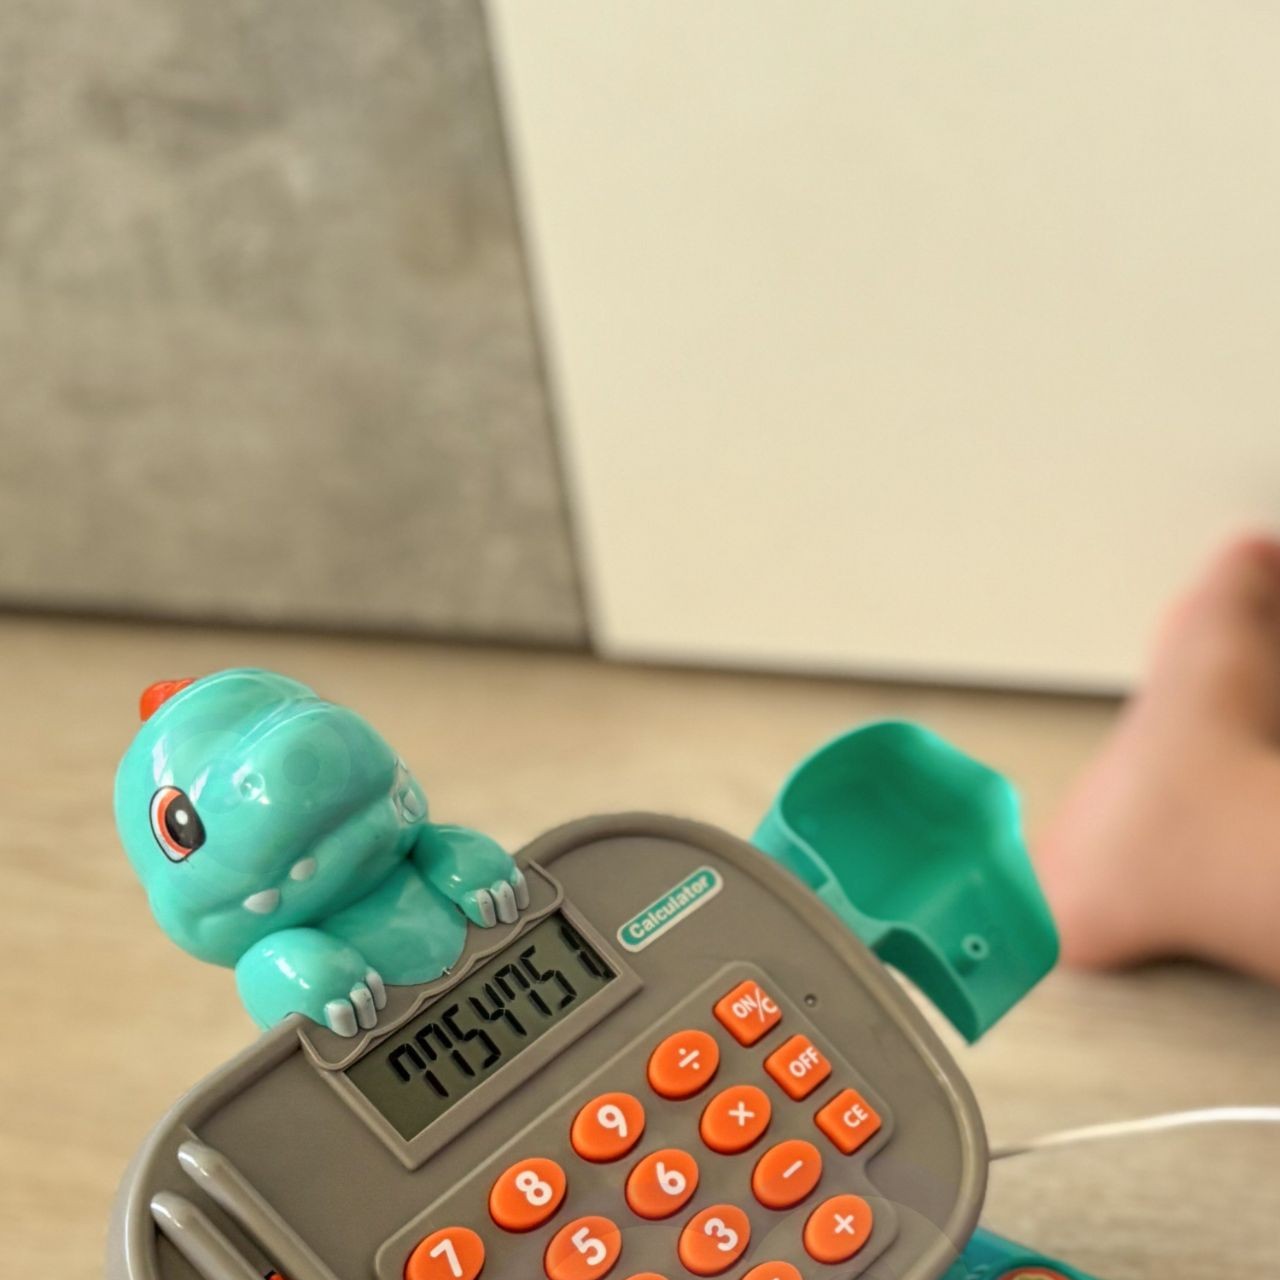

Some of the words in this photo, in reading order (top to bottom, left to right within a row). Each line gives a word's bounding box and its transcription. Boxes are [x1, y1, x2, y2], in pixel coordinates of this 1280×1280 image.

[628, 876, 709, 939] Calculator
[388, 926, 603, 1098] 7754751
[731, 987, 779, 1022] ON/C
[789, 1046, 820, 1078] OFF
[596, 1103, 629, 1139] 9
[843, 1104, 869, 1128] CE
[515, 1170, 553, 1207] 8
[655, 1161, 687, 1197] 6
[571, 1227, 607, 1267] 5
[704, 1217, 739, 1252] 3
[430, 1238, 463, 1279] 7
